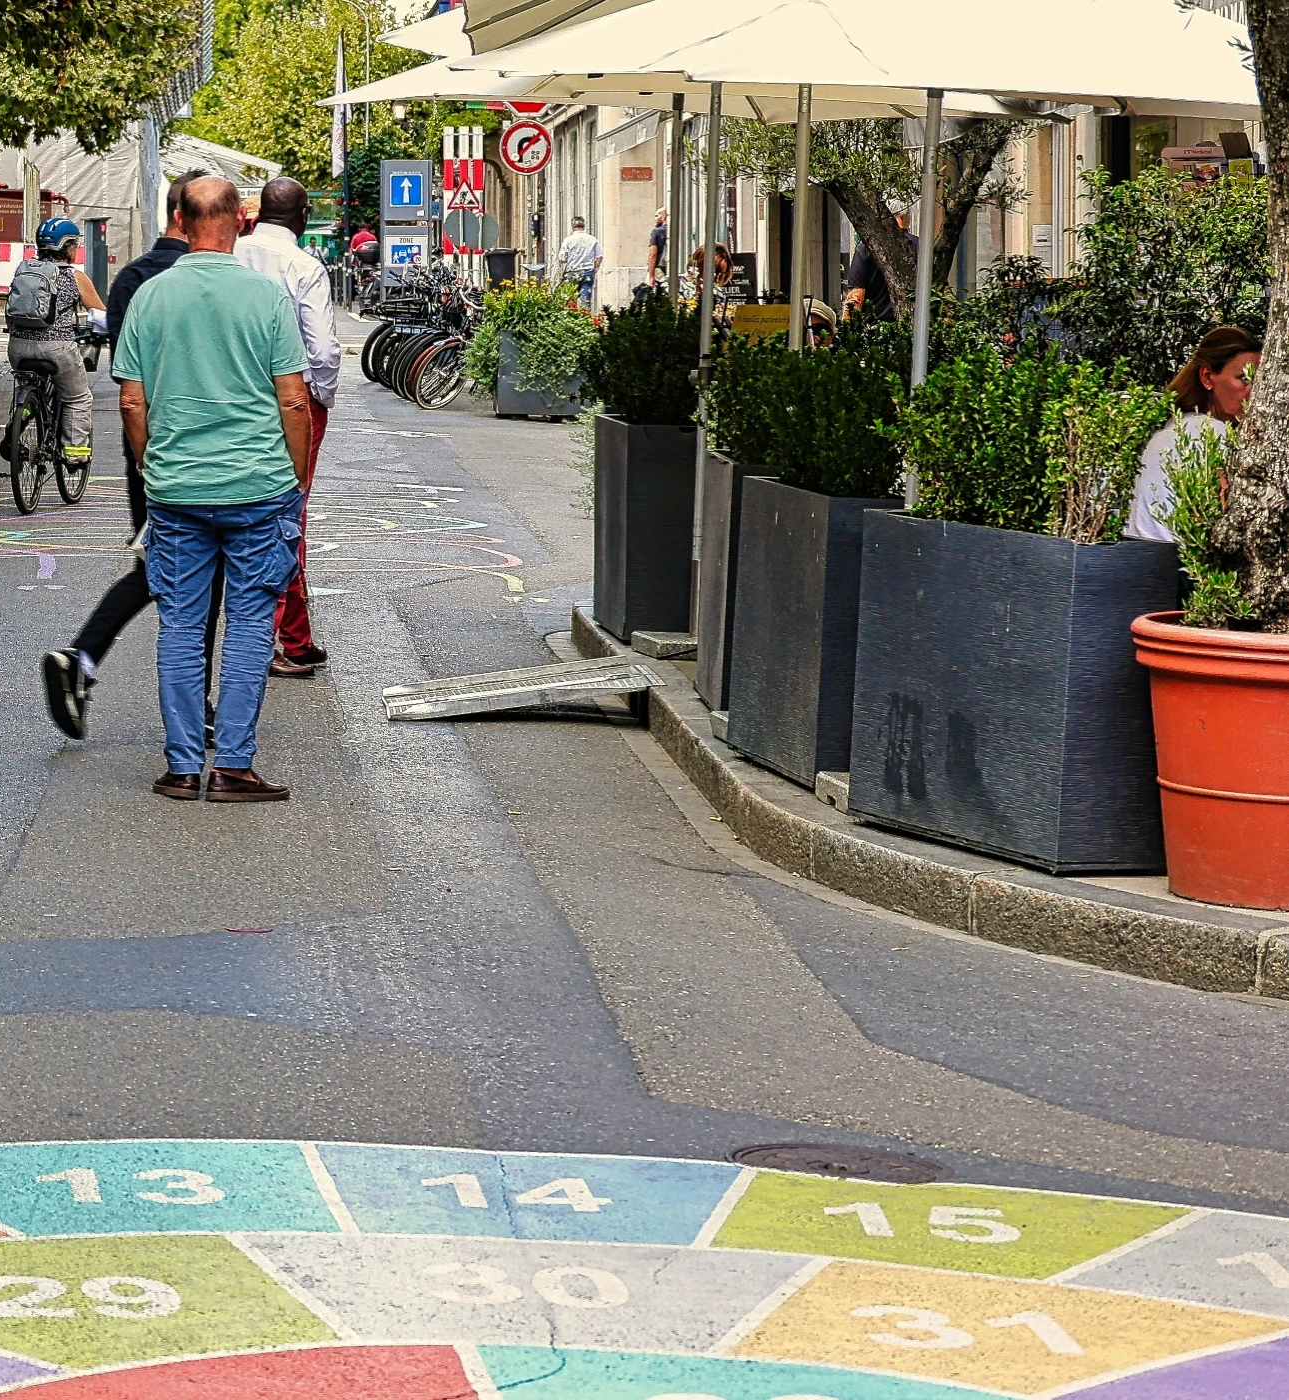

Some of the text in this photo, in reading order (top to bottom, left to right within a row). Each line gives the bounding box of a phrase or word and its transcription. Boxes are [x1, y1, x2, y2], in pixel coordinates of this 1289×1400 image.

[36, 1167, 225, 1205] 13
[420, 1173, 613, 1213] 14
[823, 1201, 1022, 1244] 15
[422, 1262, 630, 1309] 30
[849, 1303, 1084, 1356] 31
